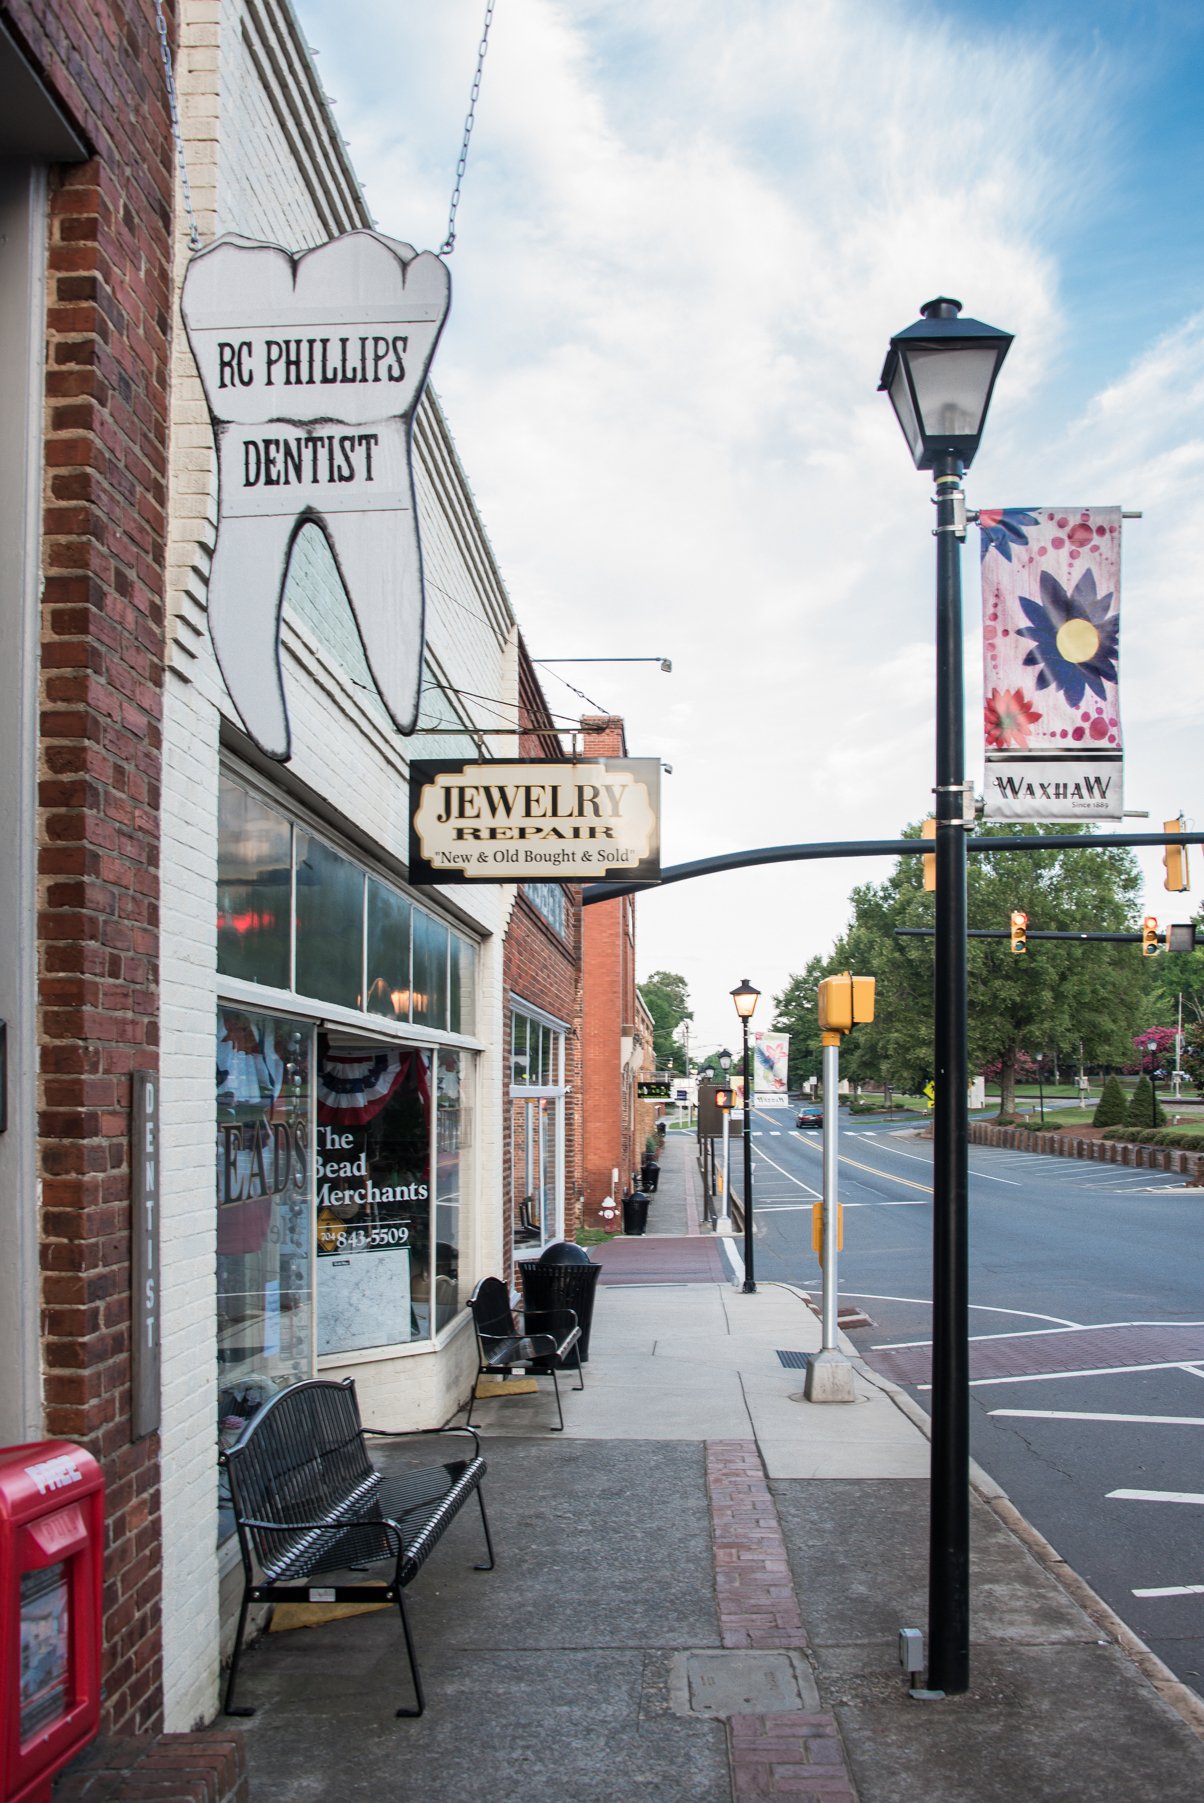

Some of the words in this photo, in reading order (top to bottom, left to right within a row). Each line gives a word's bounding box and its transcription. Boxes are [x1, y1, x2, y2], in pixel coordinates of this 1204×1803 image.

[217, 341, 254, 389] RC
[265, 336, 408, 386] PHILLIPS
[242, 434, 379, 487] DENTIST
[436, 784, 629, 823] JEWELRY
[1093, 801, 1109, 809] 1889
[452, 826, 616, 841] REPAIR
[435, 851, 473, 863] "New
[477, 851, 489, 863] &
[493, 849, 519, 863] Old
[524, 849, 576, 866] Bought
[581, 850, 593, 862] &
[597, 848, 635, 862] Sold"
[219, 1119, 307, 1205] EADS
[315, 1152, 367, 1178] Bead
[315, 1180, 428, 1206] Merchants
[145, 1082, 155, 1348] DENTIST
[336, 1227, 409, 1248] 843-5509
[24, 1454, 82, 1495] FREE
